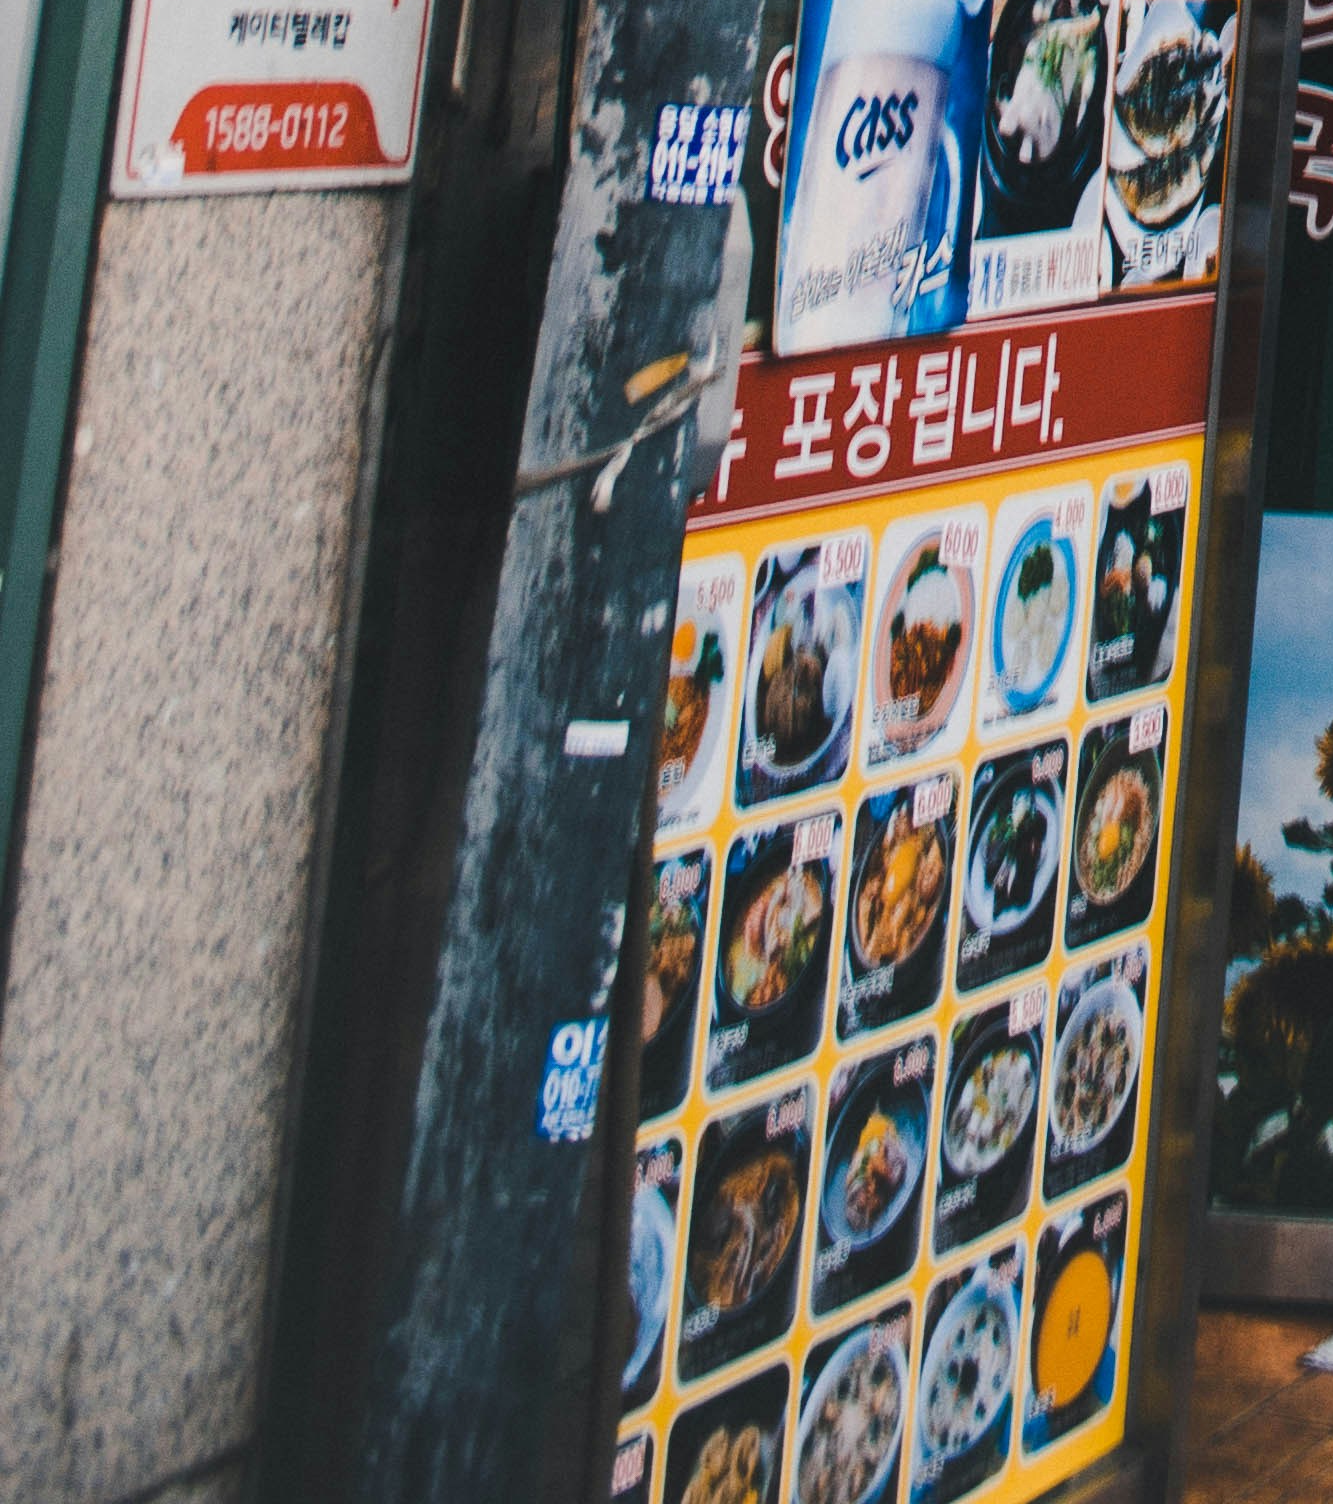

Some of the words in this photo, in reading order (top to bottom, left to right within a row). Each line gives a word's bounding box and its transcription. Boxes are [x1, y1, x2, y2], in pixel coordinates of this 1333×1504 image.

[227, 7, 351, 51] 케이티텔레캅
[205, 100, 349, 153] 1588-0112
[891, 230, 954, 312] 카스
[1120, 232, 1200, 273] 고등어구이
